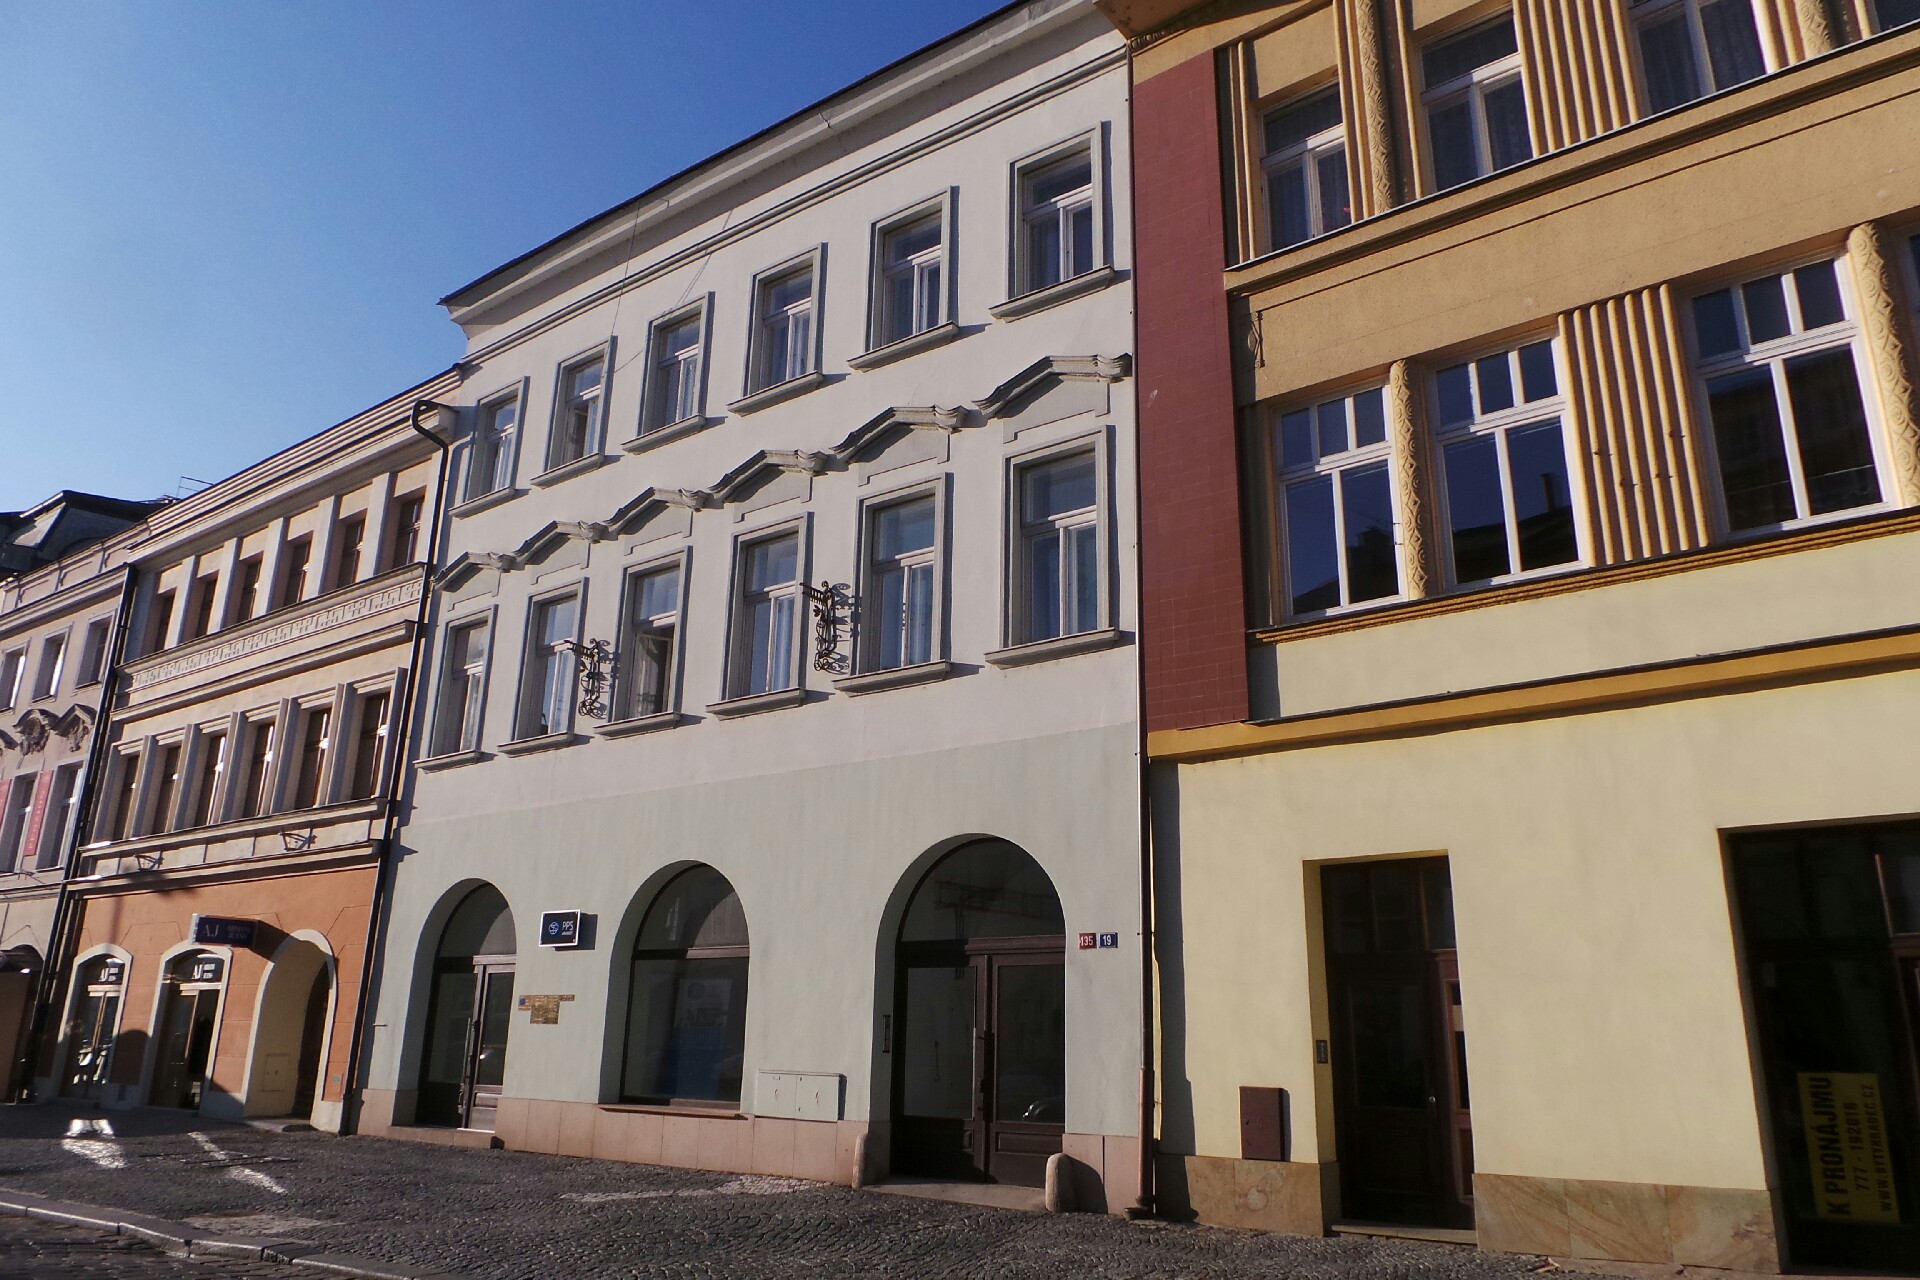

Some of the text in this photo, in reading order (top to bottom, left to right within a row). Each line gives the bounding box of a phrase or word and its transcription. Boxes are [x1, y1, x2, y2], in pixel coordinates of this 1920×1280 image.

[562, 920, 574, 931] PPS
[1080, 935, 1094, 946] 135
[1102, 934, 1112, 946] 19
[1808, 1076, 1852, 1215] K PRONÁJMU
[1852, 1166, 1871, 1191] 777
